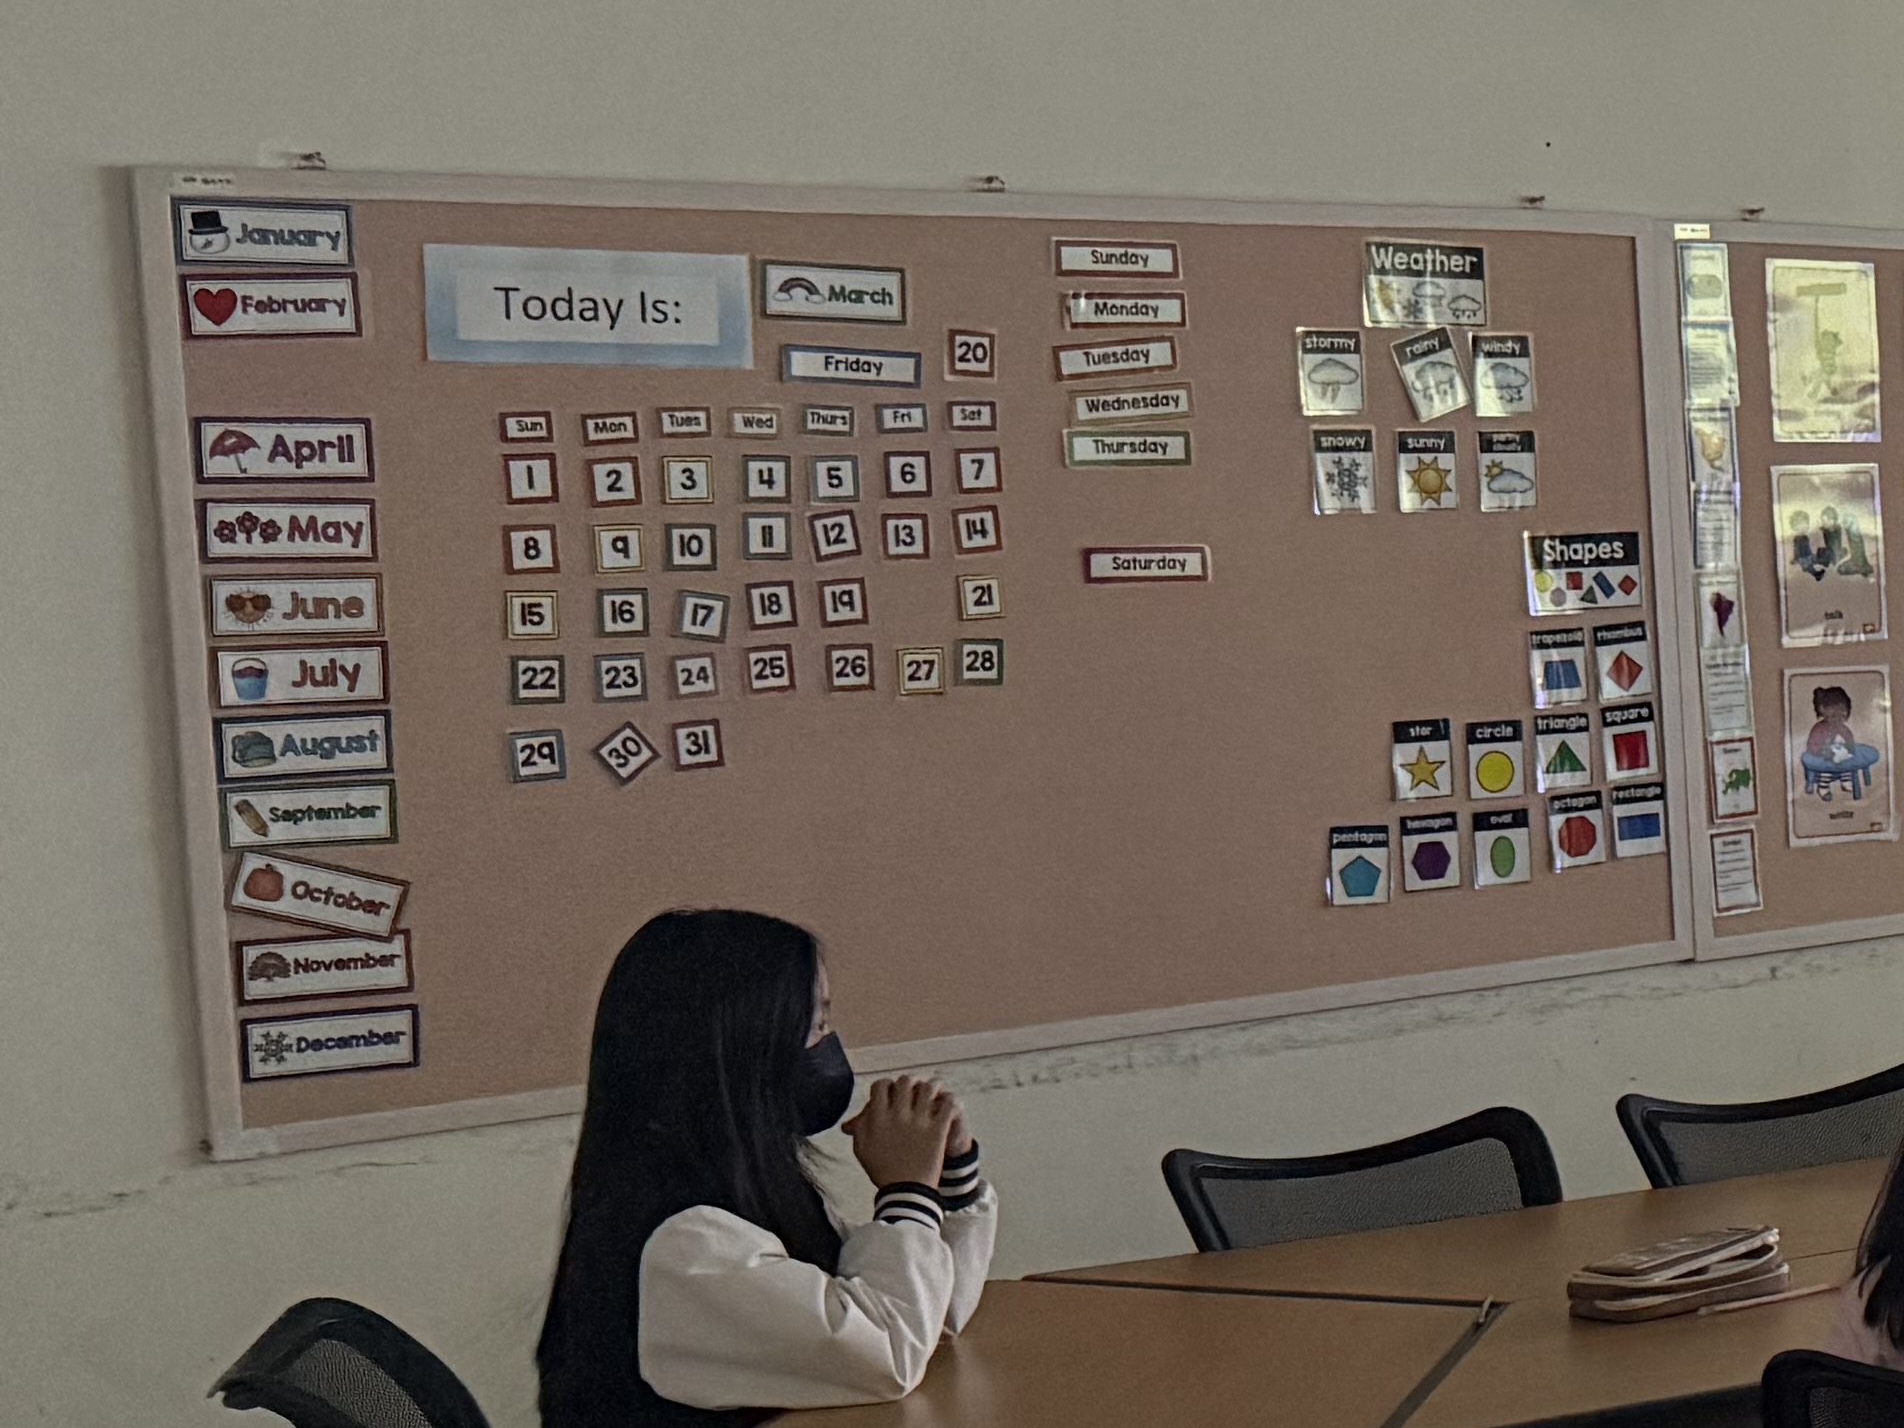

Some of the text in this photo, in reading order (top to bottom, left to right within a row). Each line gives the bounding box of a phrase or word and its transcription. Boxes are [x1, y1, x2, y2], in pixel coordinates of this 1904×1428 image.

[235, 223, 341, 252] January
[1090, 249, 1149, 268] Sunday
[1371, 245, 1478, 273] Weather
[241, 295, 346, 317] February
[828, 283, 894, 307] March
[494, 286, 682, 331] Today Is:
[1094, 300, 1159, 319] Monday
[957, 343, 988, 364] 20
[1305, 335, 1356, 351] stormy
[1406, 336, 1440, 357] rainy
[1481, 340, 1521, 355] windy
[824, 355, 883, 377] Friday
[1082, 346, 1150, 367] Tuesday
[960, 408, 982, 421] Sat
[1085, 392, 1180, 414] Wednesday
[516, 420, 544, 432] Sun
[593, 422, 627, 434] Mon
[668, 414, 702, 427] Tues
[741, 415, 774, 429] Wed
[810, 411, 848, 426] Thurs
[893, 411, 912, 423] Fri
[267, 434, 355, 471] April
[1092, 438, 1169, 458] Thursday
[1321, 435, 1366, 449] snowy
[1407, 436, 1446, 451] sunny
[526, 464, 536, 490] 1
[680, 467, 697, 490] 3
[758, 467, 775, 490] 4
[826, 466, 843, 489] 5
[900, 462, 916, 484] 6
[970, 458, 985, 480] 7
[606, 469, 624, 493] 2
[287, 515, 364, 548] May
[761, 525, 774, 548] 11
[822, 522, 847, 547] 12
[894, 524, 916, 547] 13
[965, 517, 988, 541] 14
[524, 536, 541, 560] 8
[611, 535, 630, 559] 9
[679, 534, 704, 557] 10
[1543, 538, 1625, 564] Shapes
[1111, 553, 1187, 573] Saturday
[281, 591, 364, 621] June
[759, 593, 783, 616] 18
[831, 589, 855, 613] 19
[972, 584, 994, 607] 21
[520, 602, 545, 626] 15
[610, 600, 635, 624] 16
[691, 603, 715, 627] 17
[753, 657, 785, 681] 25
[835, 656, 867, 678] 26
[907, 659, 935, 682] 27
[965, 650, 995, 672] 28
[291, 658, 362, 694] July
[521, 666, 556, 690] 22
[604, 666, 639, 690] 23
[680, 666, 709, 686] 24
[1537, 715, 1587, 731] triangle
[1605, 707, 1649, 723] square
[685, 730, 711, 756] 31
[1409, 726, 1433, 737] star
[1476, 726, 1514, 739] circle
[279, 729, 380, 761] August
[519, 742, 556, 767] 29
[608, 736, 642, 768] 30
[269, 803, 381, 829] September
[291, 880, 391, 918] October
[293, 952, 401, 977] November
[295, 1029, 407, 1056] December
